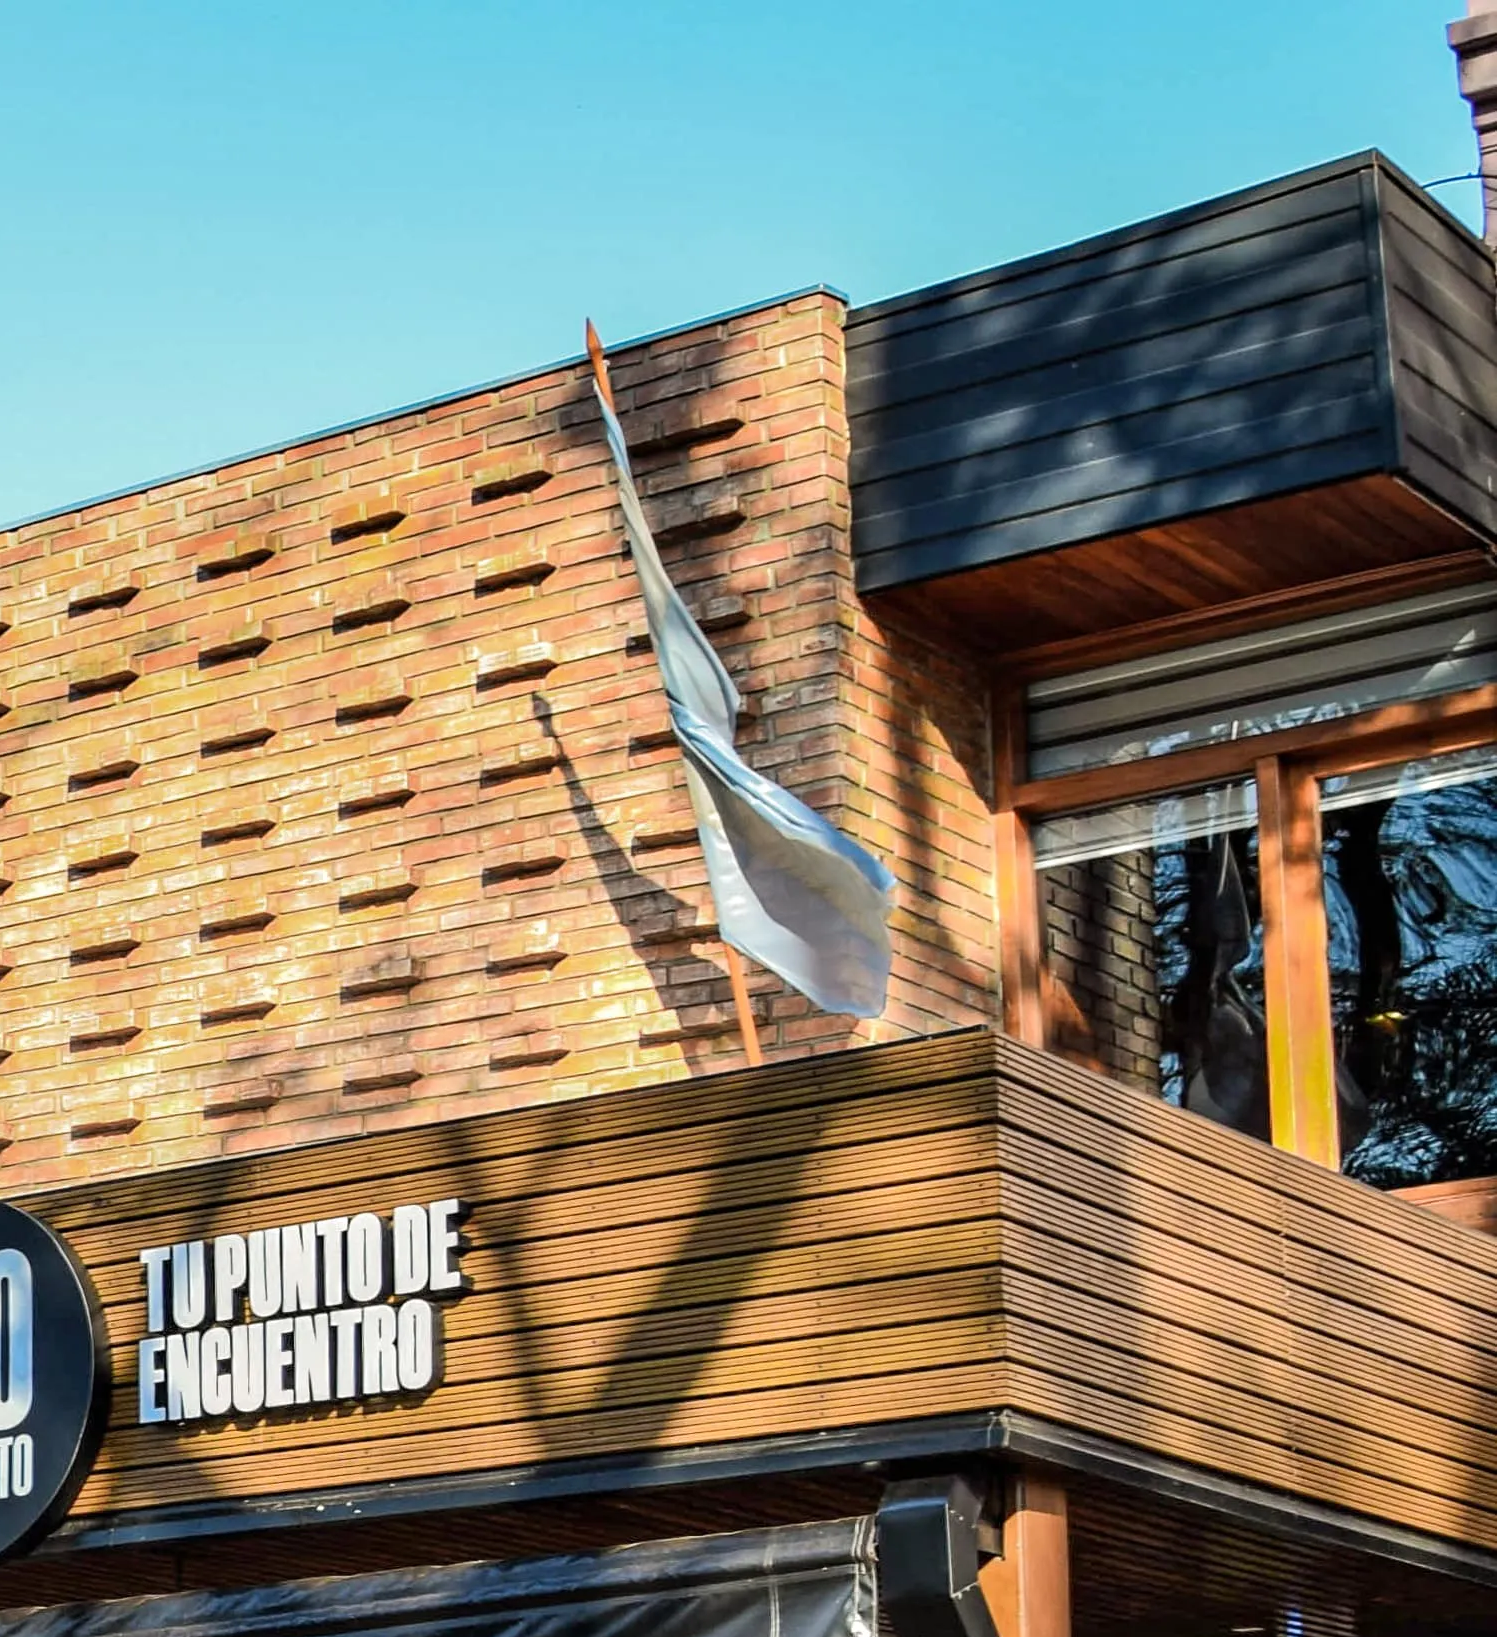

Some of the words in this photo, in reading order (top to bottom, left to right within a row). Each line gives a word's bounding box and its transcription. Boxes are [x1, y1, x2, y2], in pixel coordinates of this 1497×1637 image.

[140, 1241, 206, 1332] TU
[214, 1212, 383, 1321] PUNTO
[393, 1199, 461, 1294] DE
[139, 1299, 433, 1423] ENCUENTRO
